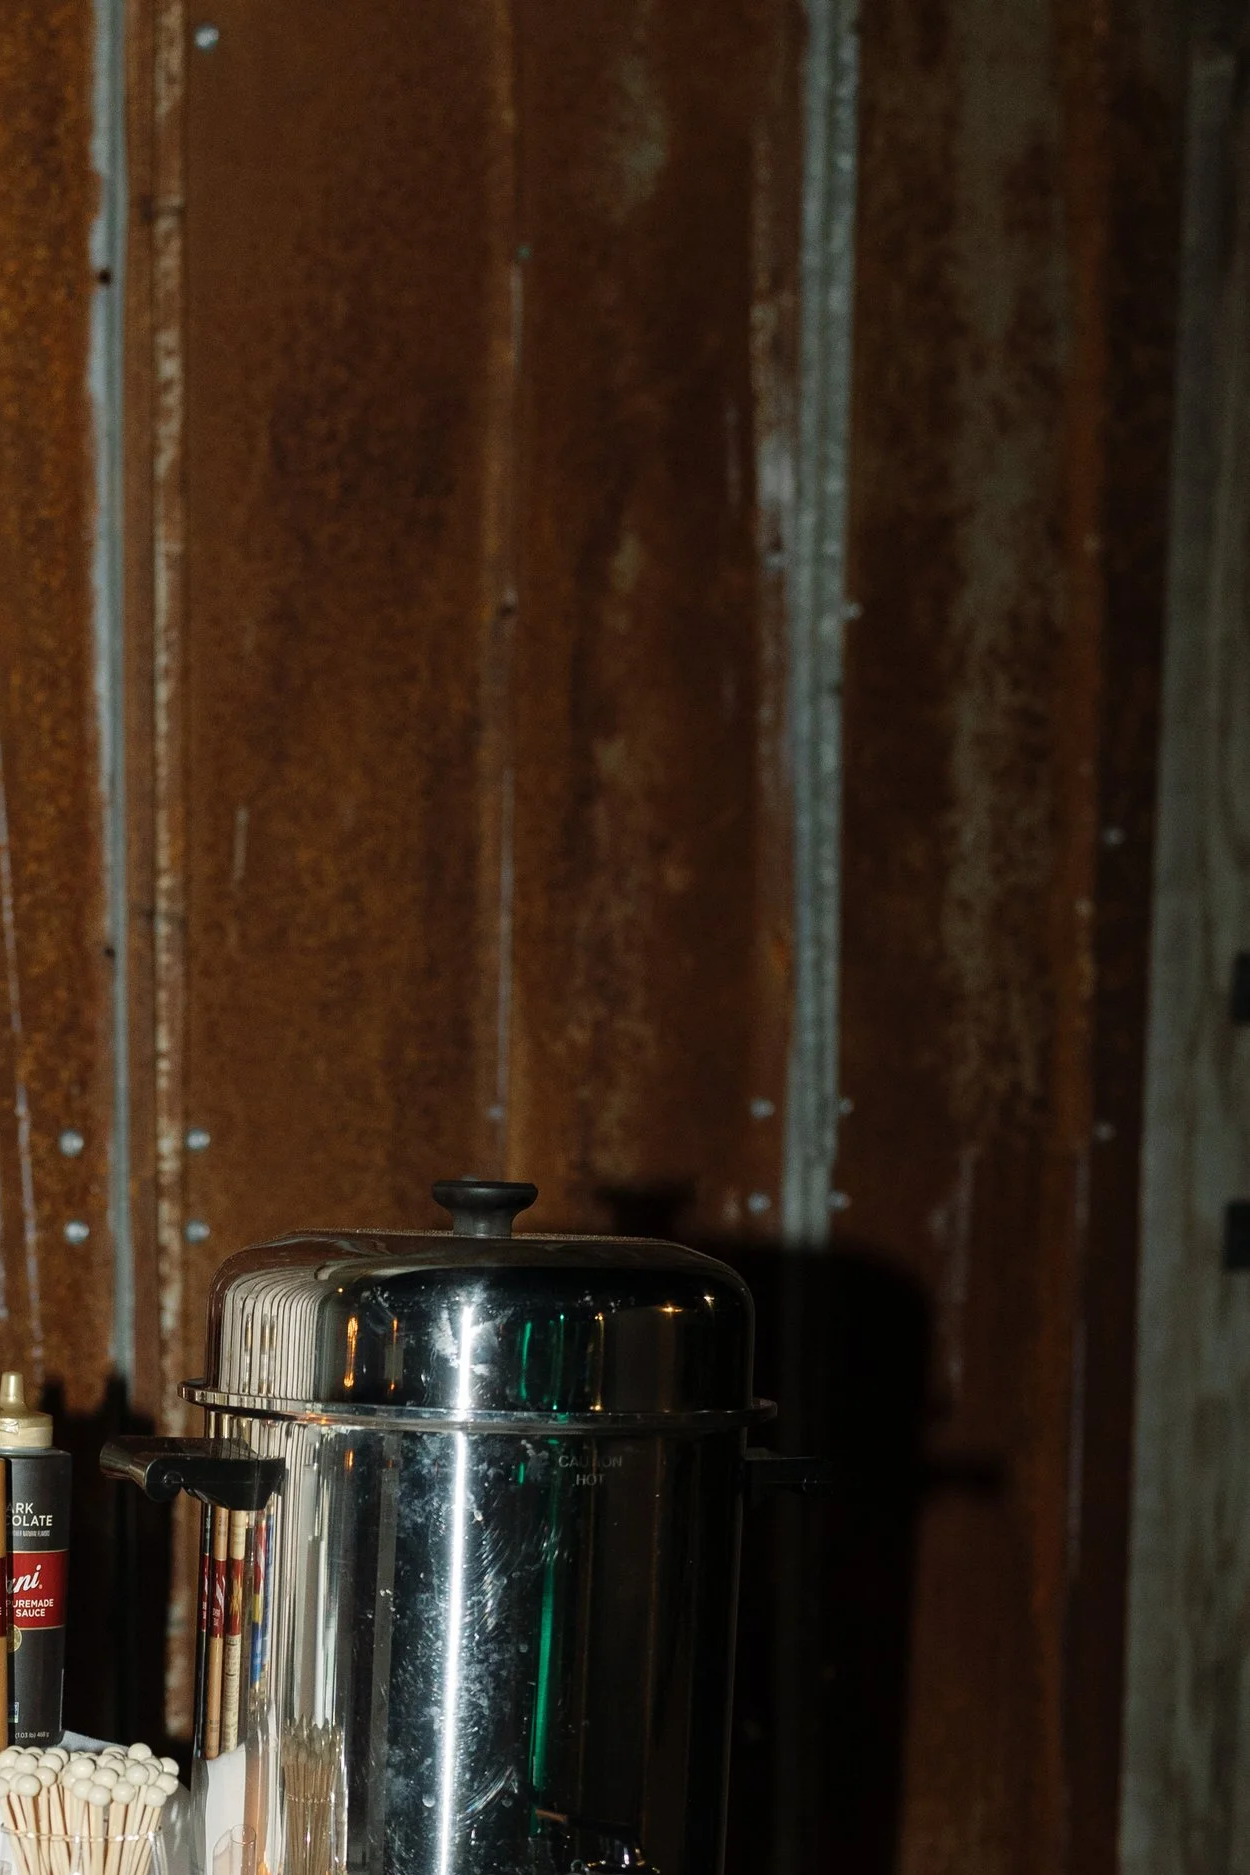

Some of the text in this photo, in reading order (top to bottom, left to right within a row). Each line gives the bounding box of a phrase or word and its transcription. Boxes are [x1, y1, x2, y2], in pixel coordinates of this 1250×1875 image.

[558, 1455, 622, 1468] CAUION
[576, 1473, 606, 1486] HOT
[16, 1609, 46, 1618] SAUCE
